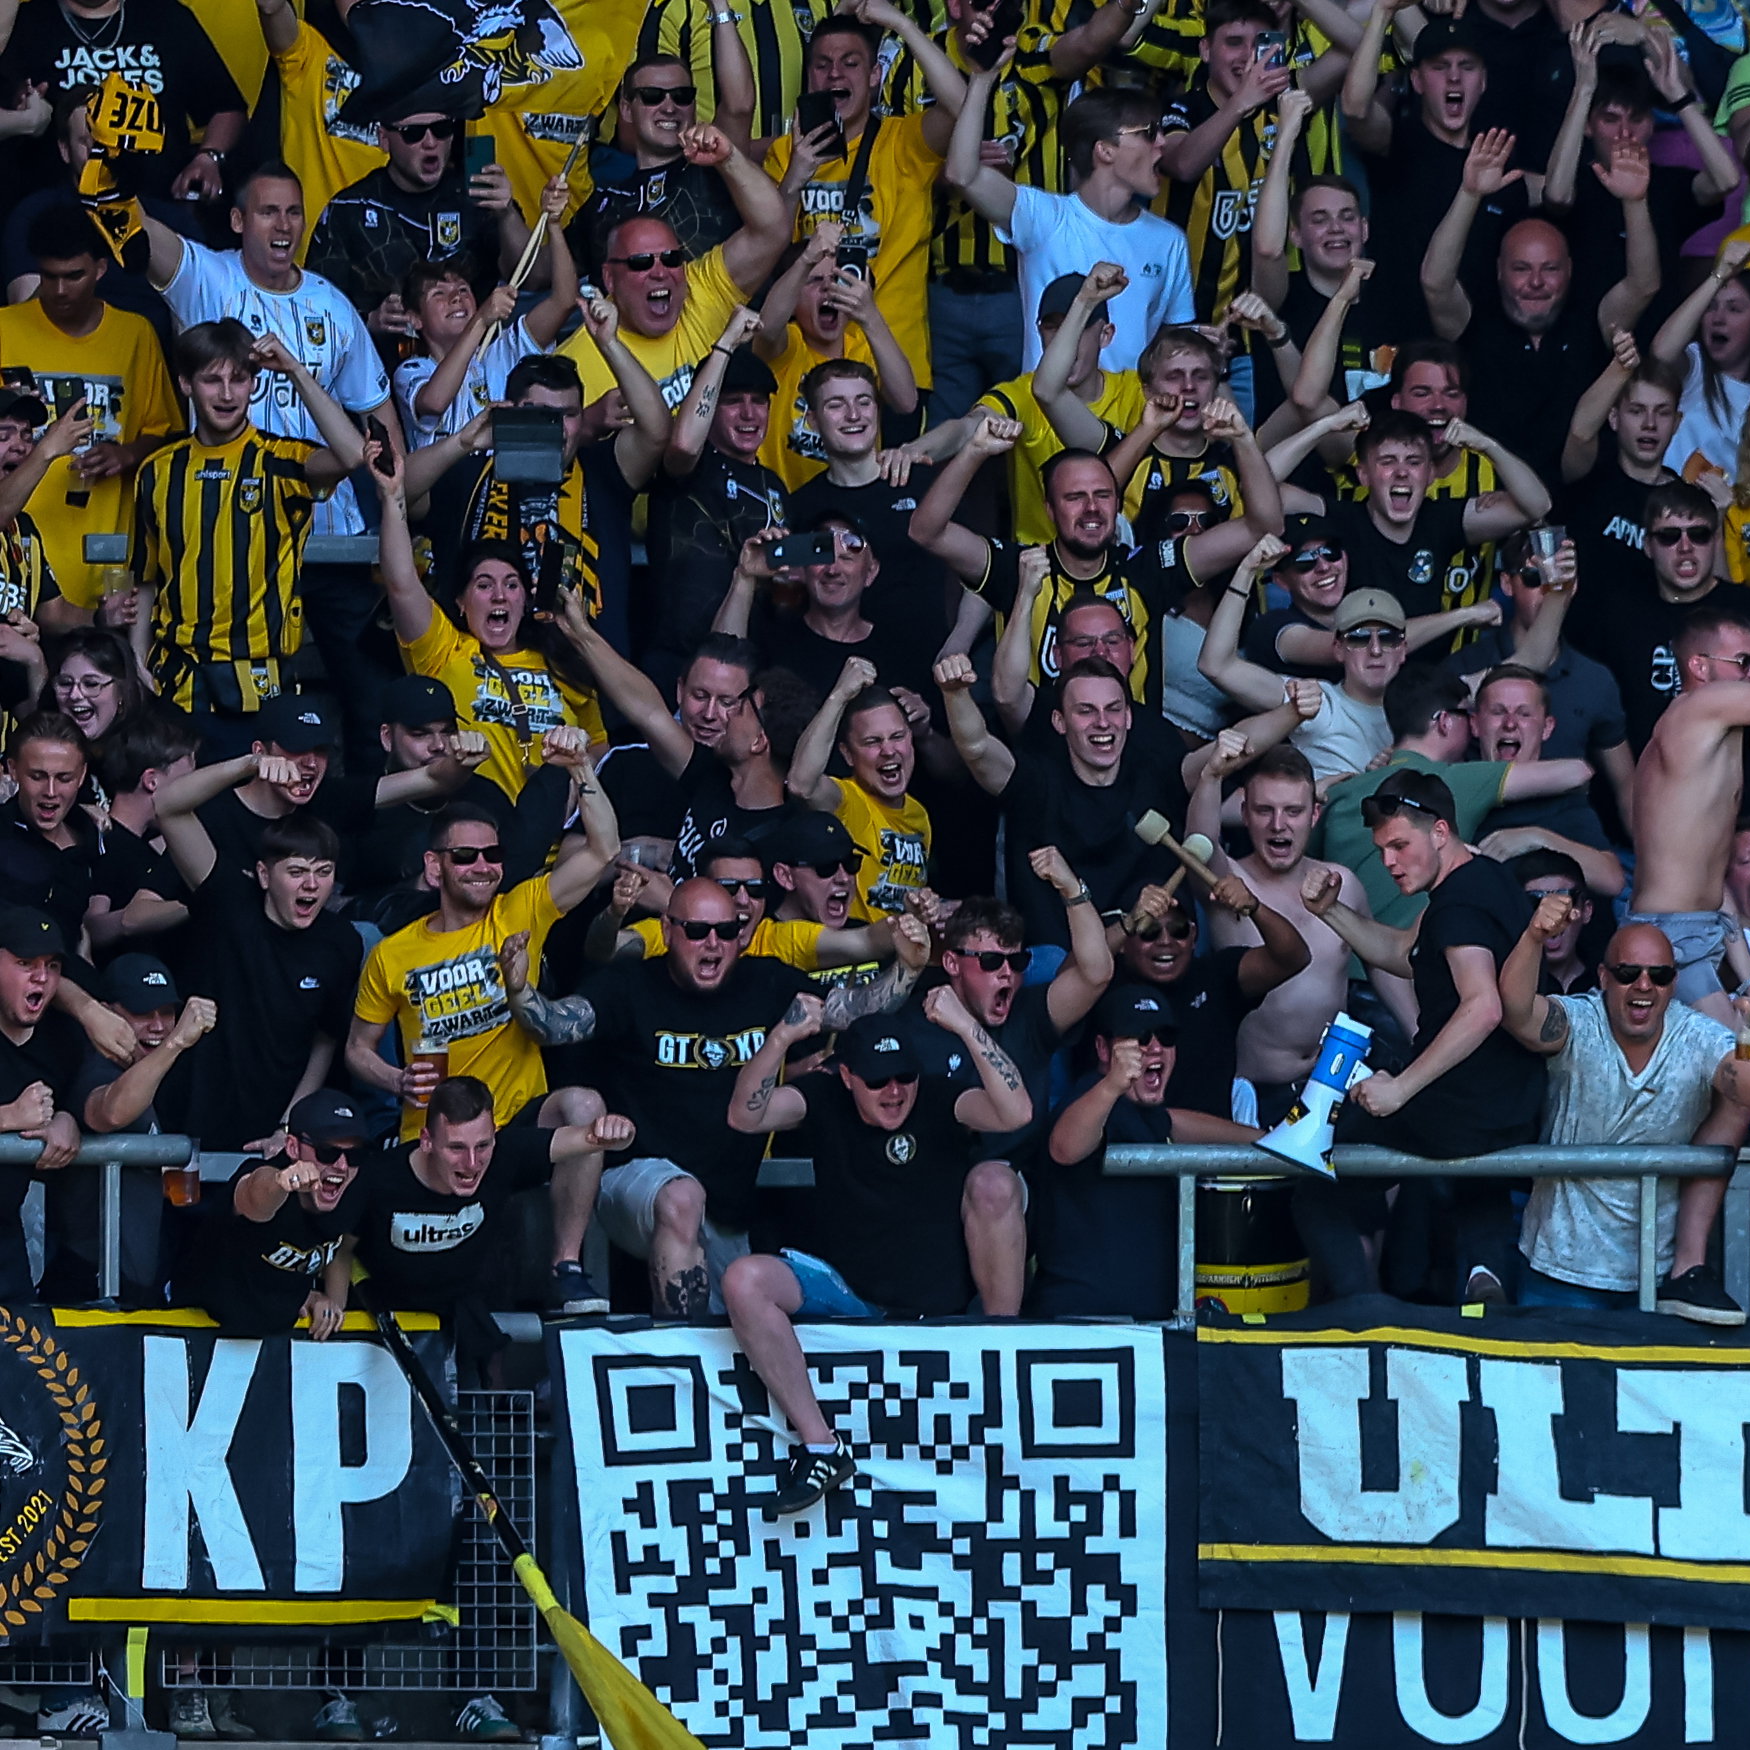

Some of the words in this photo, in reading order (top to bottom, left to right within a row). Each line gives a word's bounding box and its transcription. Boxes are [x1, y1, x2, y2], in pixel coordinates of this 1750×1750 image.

[56, 43, 163, 70] JACK&
[59, 69, 165, 96] JOES
[421, 957, 486, 994] VOOR
[423, 983, 492, 1019] GEEL
[430, 1005, 497, 1037] ZWART
[658, 1034, 690, 1065] GT
[403, 1221, 476, 1245] ultras
[142, 1334, 414, 1594] KP
